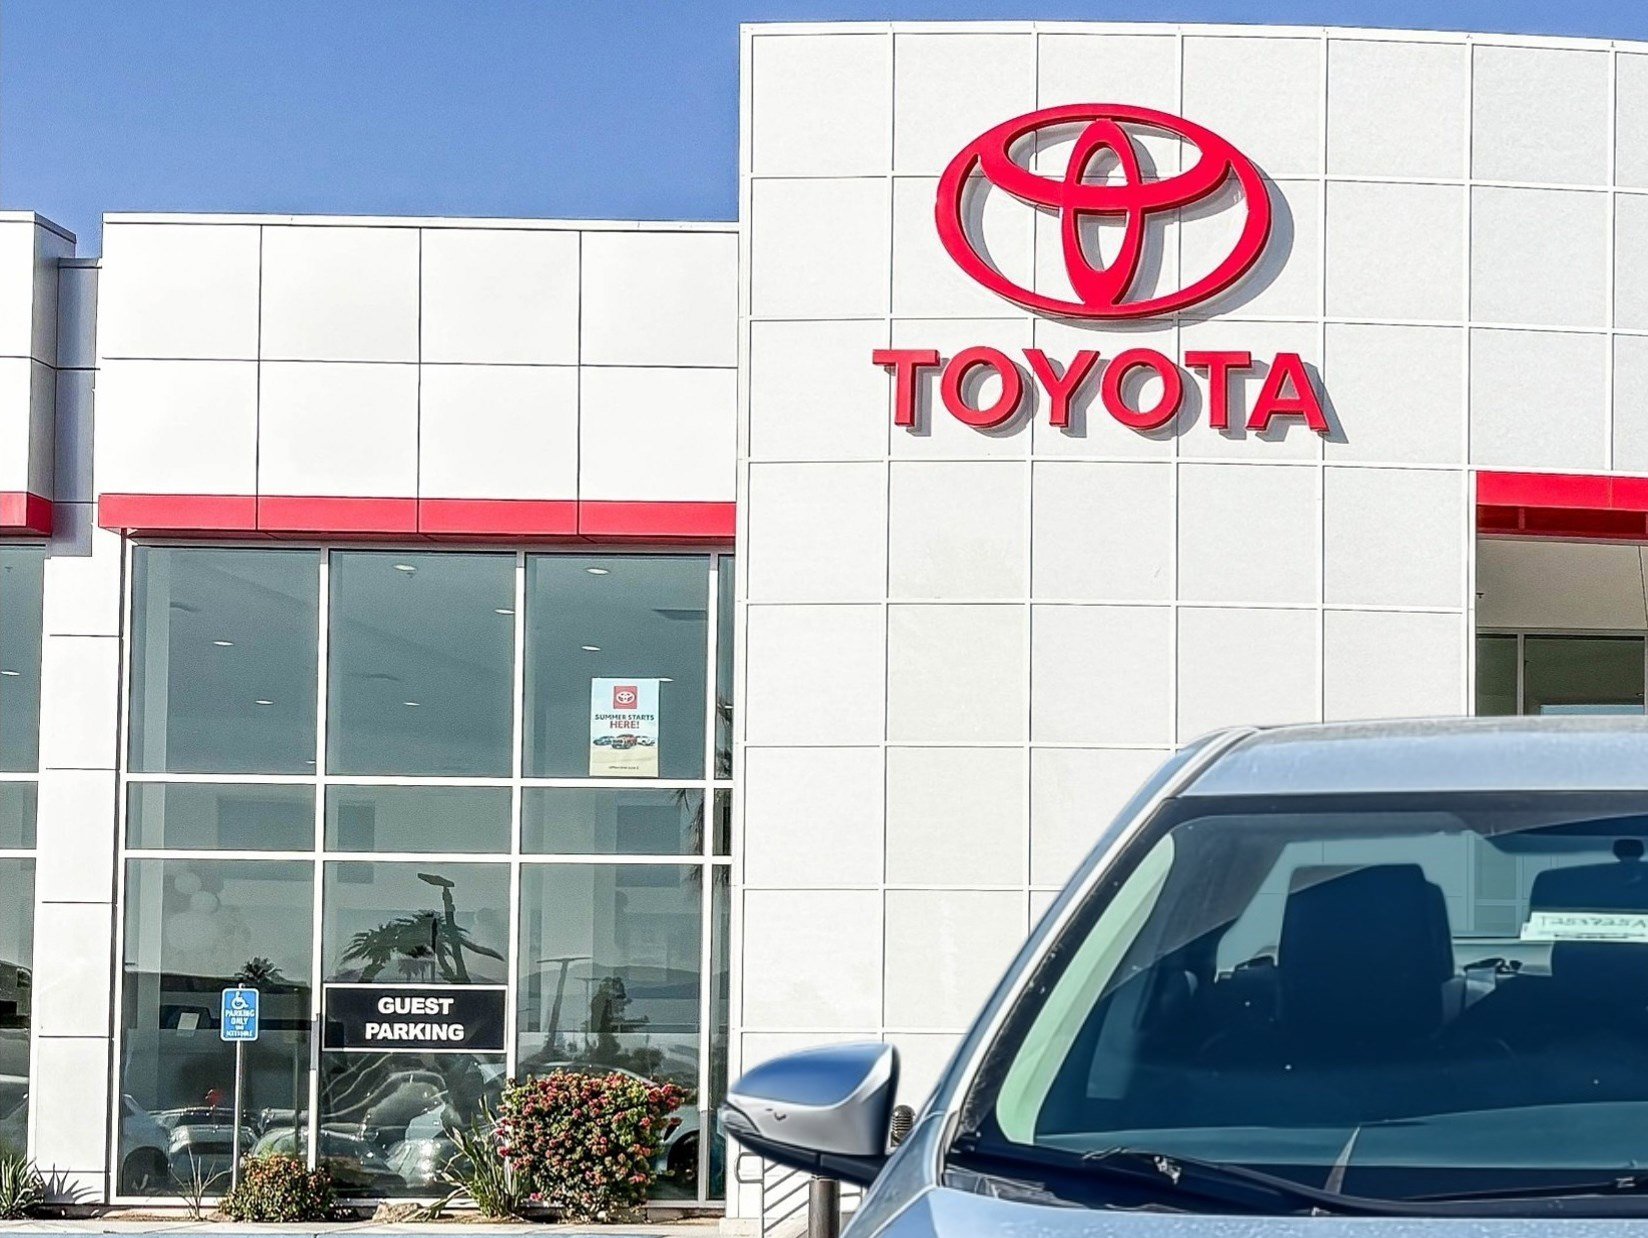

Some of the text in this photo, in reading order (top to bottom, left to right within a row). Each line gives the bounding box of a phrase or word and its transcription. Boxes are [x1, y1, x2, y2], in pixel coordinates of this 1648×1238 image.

[872, 345, 1330, 433] TOYOTA
[609, 720, 640, 729] HERE!
[377, 996, 455, 1015] GUEST
[225, 1009, 255, 1018] PARKING
[230, 1017, 249, 1025] ONLY
[364, 1022, 465, 1041] PARKING
